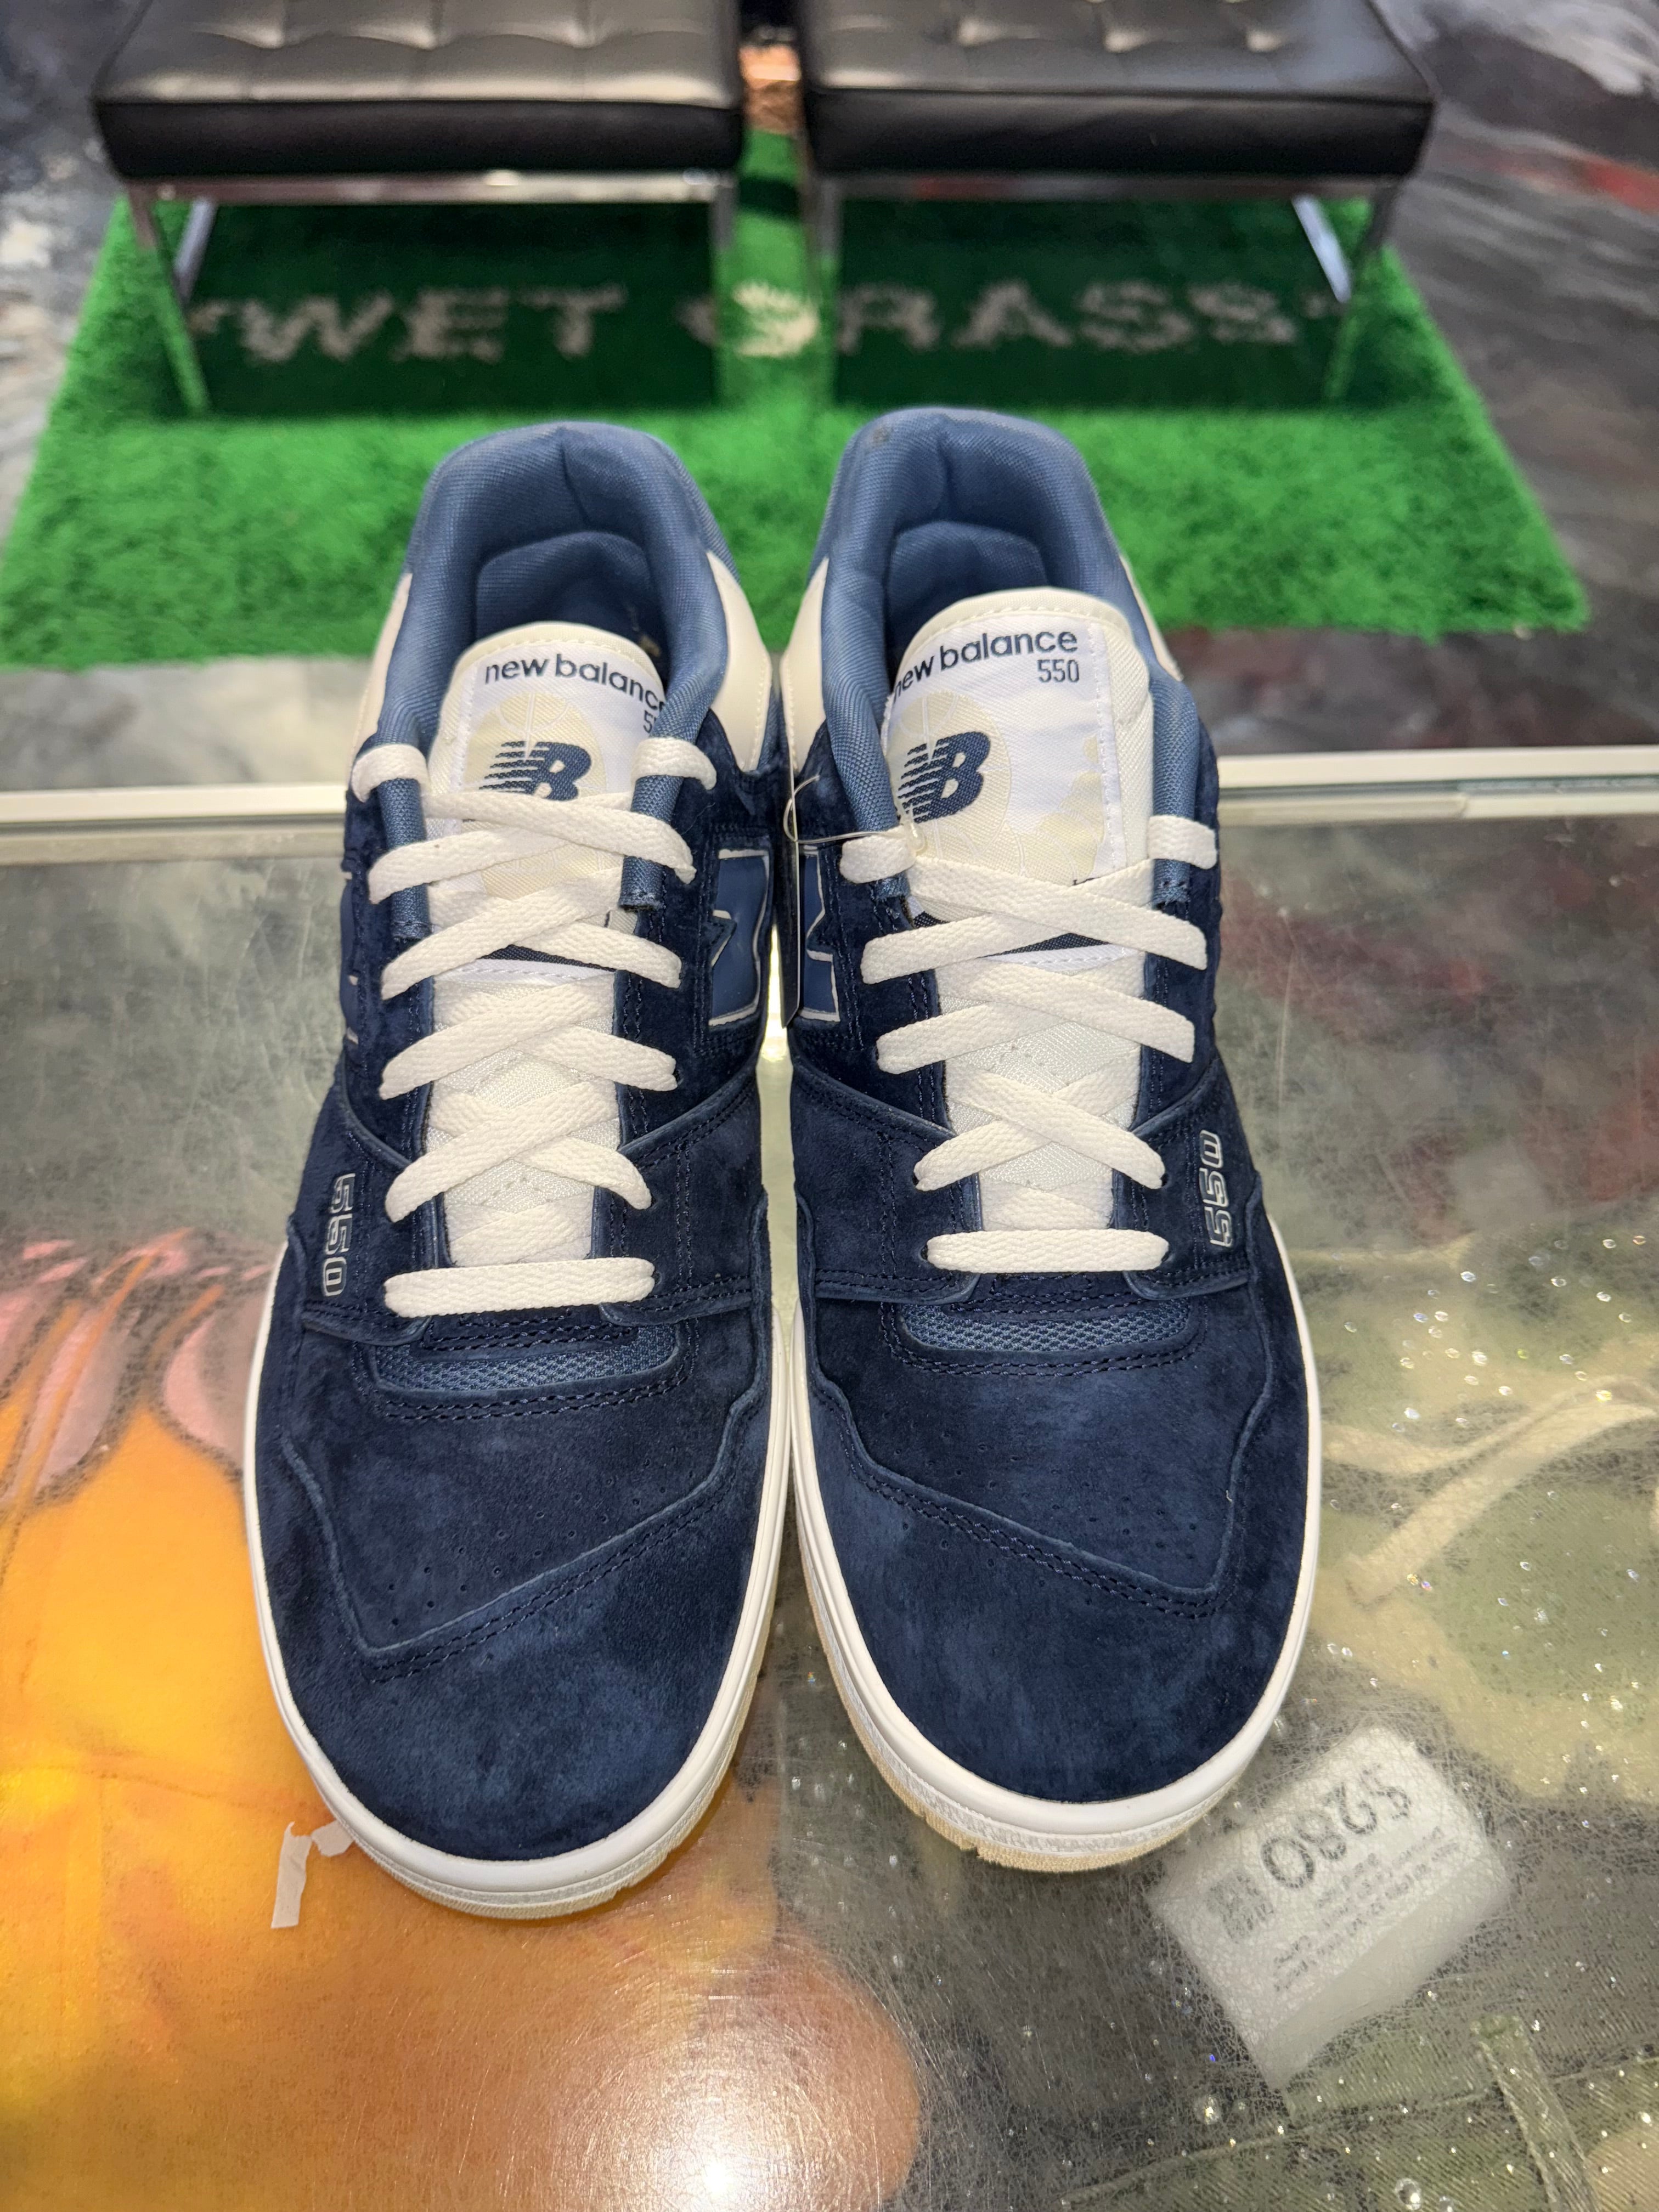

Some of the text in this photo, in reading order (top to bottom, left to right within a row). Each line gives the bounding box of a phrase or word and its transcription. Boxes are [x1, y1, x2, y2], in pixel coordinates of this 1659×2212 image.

[940, 631, 1078, 672] balance
[1037, 659, 1080, 683] 550
[485, 653, 665, 712] new balanc
[1199, 1129, 1233, 1248] 550
[321, 1172, 356, 1297] 550
